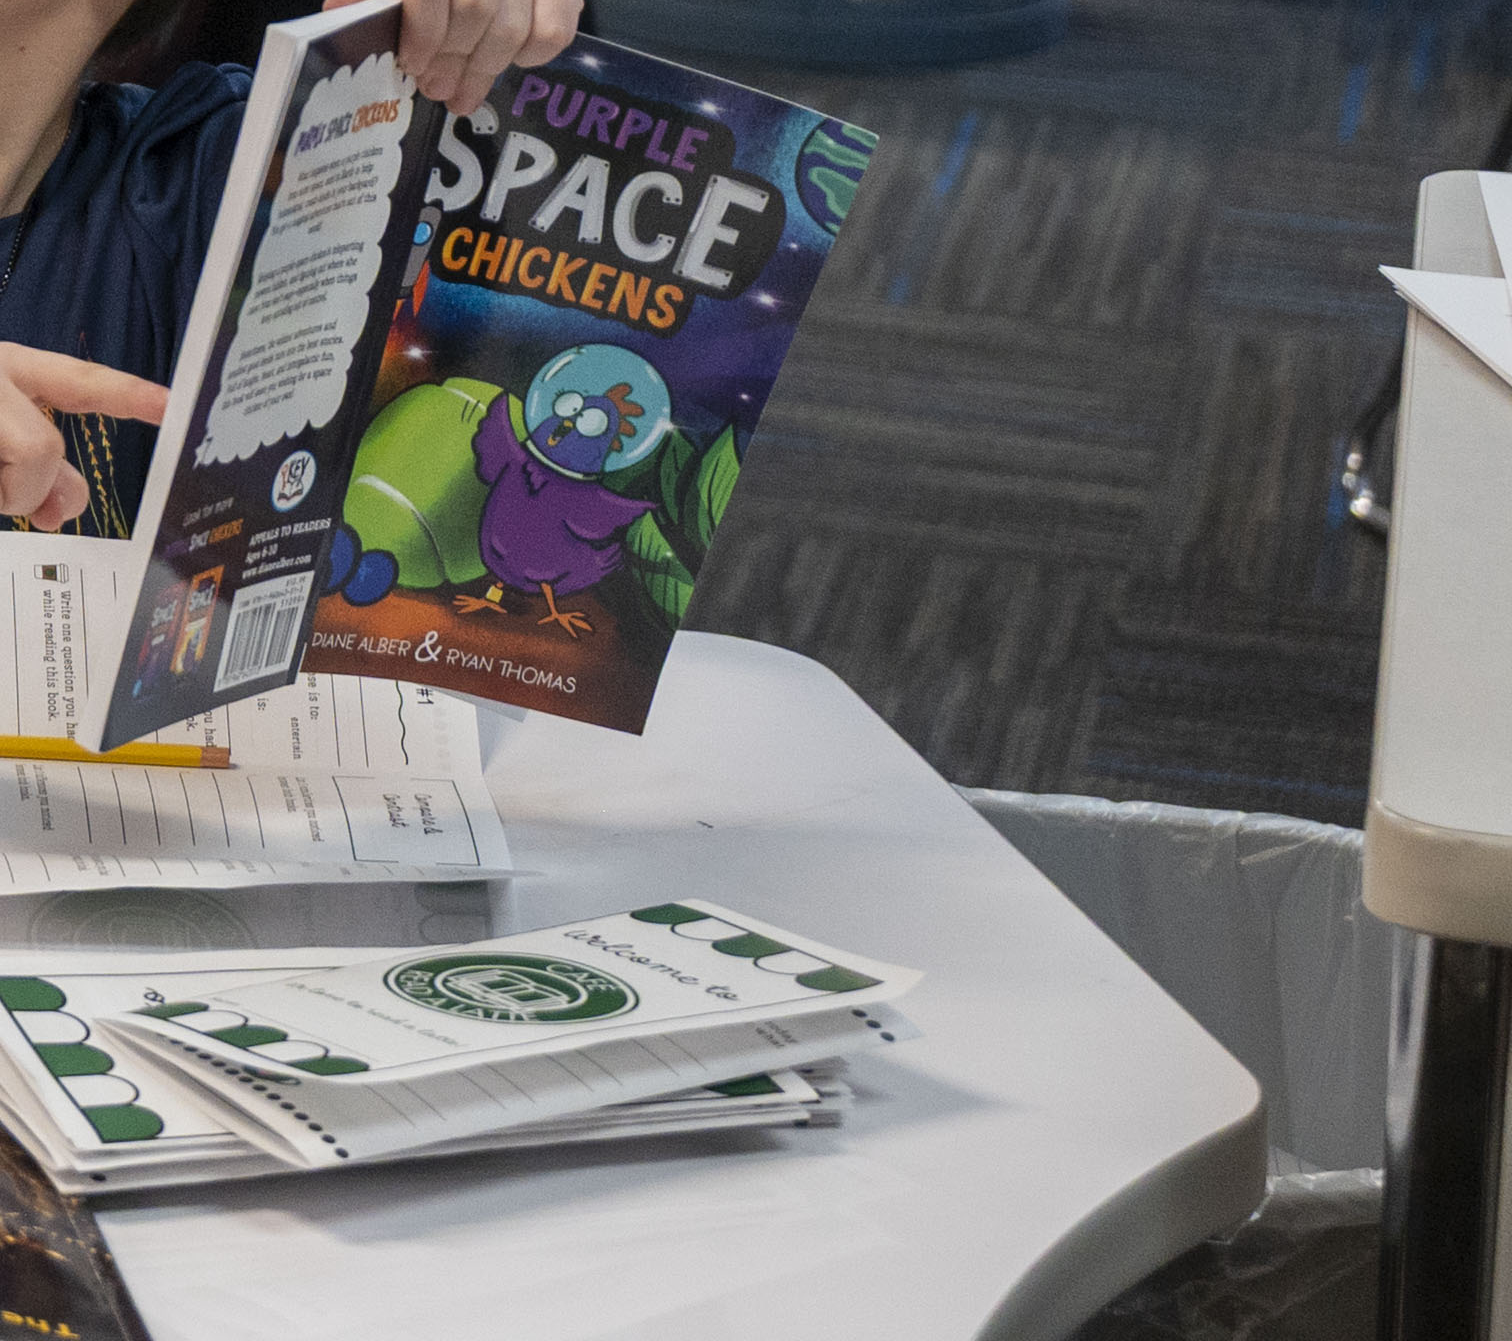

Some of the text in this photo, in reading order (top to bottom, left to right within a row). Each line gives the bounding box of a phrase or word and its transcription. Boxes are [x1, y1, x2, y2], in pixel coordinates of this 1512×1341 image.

[511, 74, 710, 173] PURPLE
[424, 101, 770, 290] SPACE
[441, 227, 685, 330] CHICKENS
[248, 517, 333, 548] APPEALS TO READERS
[55, 590, 75, 620] Write
[59, 624, 75, 642] one
[37, 588, 63, 721] while reading this book.
[51, 645, 82, 693] question
[312, 630, 578, 695] DIANE ALBER & RYAN THOMAS
[59, 696, 78, 717] you
[256, 697, 268, 711] is:
[307, 692, 320, 720] is to:
[415, 687, 434, 706] #1
[287, 716, 305, 760] entertain
[544, 962, 621, 996] CAFE
[705, 983, 742, 1003] to
[0, 1309, 81, 1340] The
